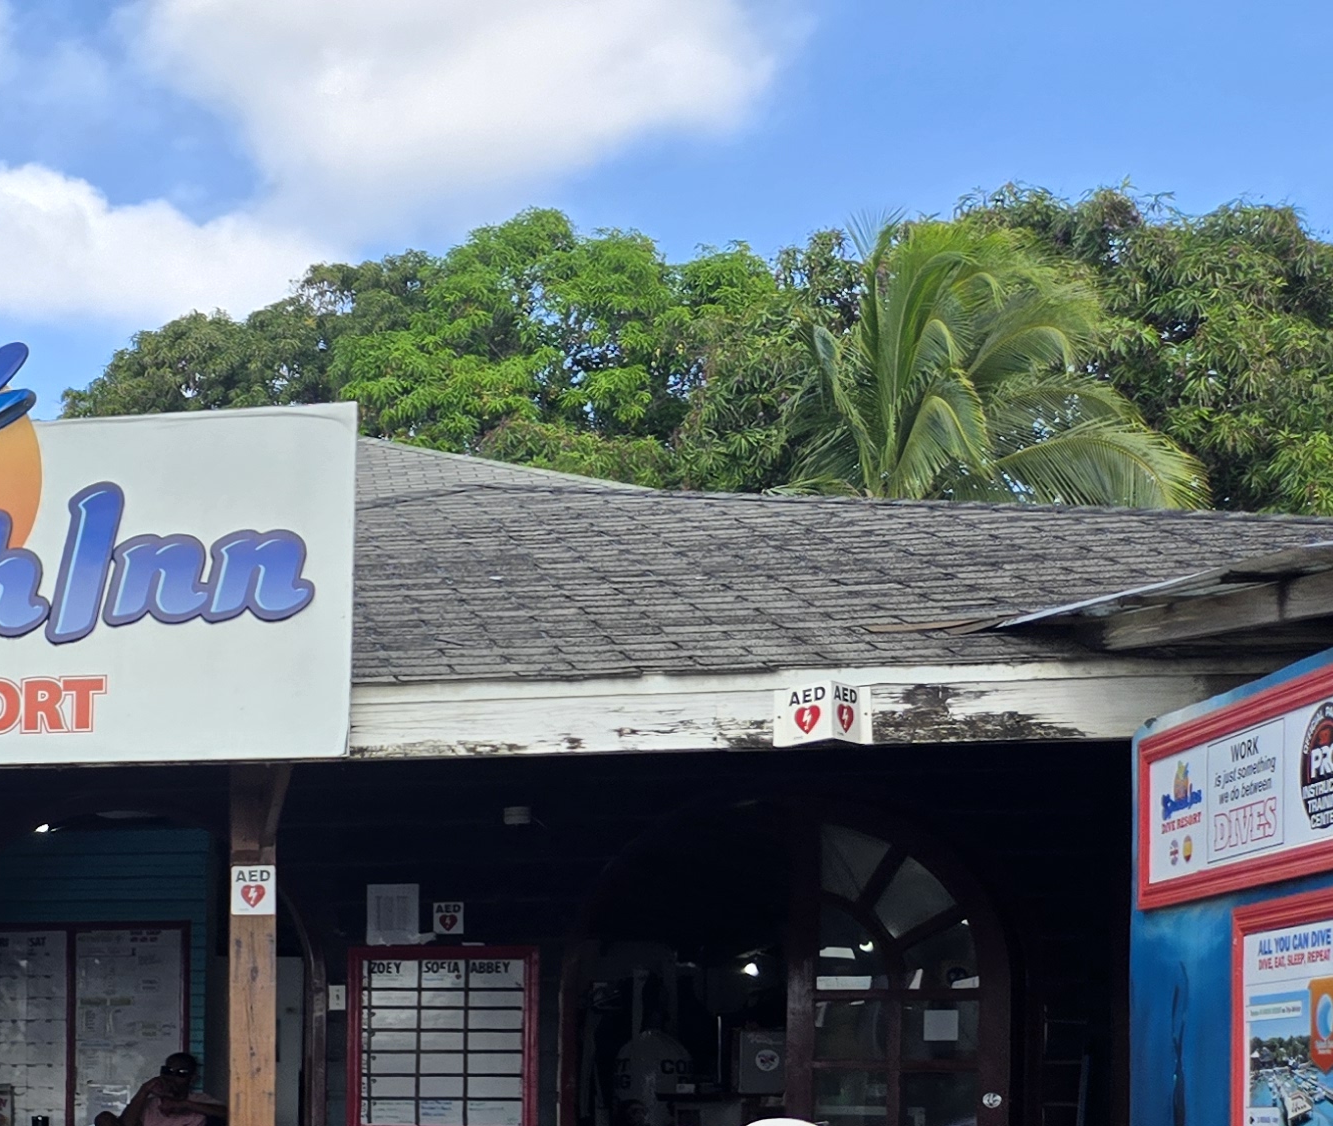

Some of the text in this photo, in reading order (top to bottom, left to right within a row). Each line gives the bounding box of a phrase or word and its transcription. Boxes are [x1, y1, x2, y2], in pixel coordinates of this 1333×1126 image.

[44, 481, 315, 644] Inn
[789, 686, 826, 706] AED
[834, 685, 858, 704] AED
[1230, 735, 1259, 762] WORK
[1214, 755, 1276, 789] is just something
[1230, 785, 1239, 801] do
[1241, 778, 1272, 798] between
[1214, 796, 1277, 852] DIVES
[236, 869, 271, 882] AED
[436, 904, 461, 913] AED
[1258, 928, 1331, 956] ALL YOU CAN DIVE
[1307, 948, 1331, 963] REPEAT
[370, 961, 402, 974] ZOEY
[470, 961, 510, 974] ABBEY
